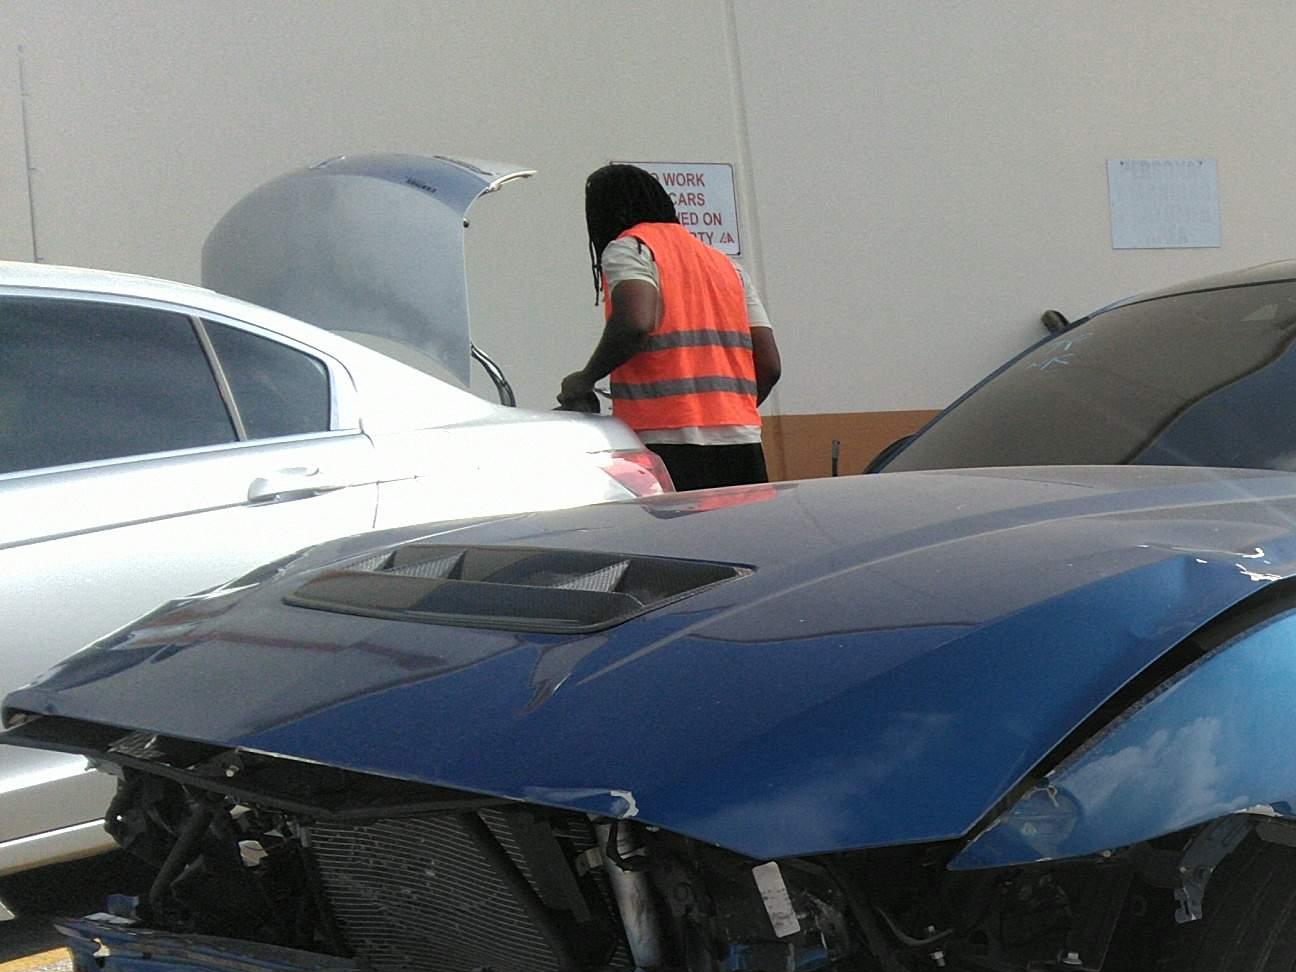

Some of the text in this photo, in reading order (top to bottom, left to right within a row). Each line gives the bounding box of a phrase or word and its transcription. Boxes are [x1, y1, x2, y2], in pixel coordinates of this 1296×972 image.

[663, 172, 705, 187] WORK
[669, 192, 705, 207] CARS
[703, 212, 722, 226] ON
